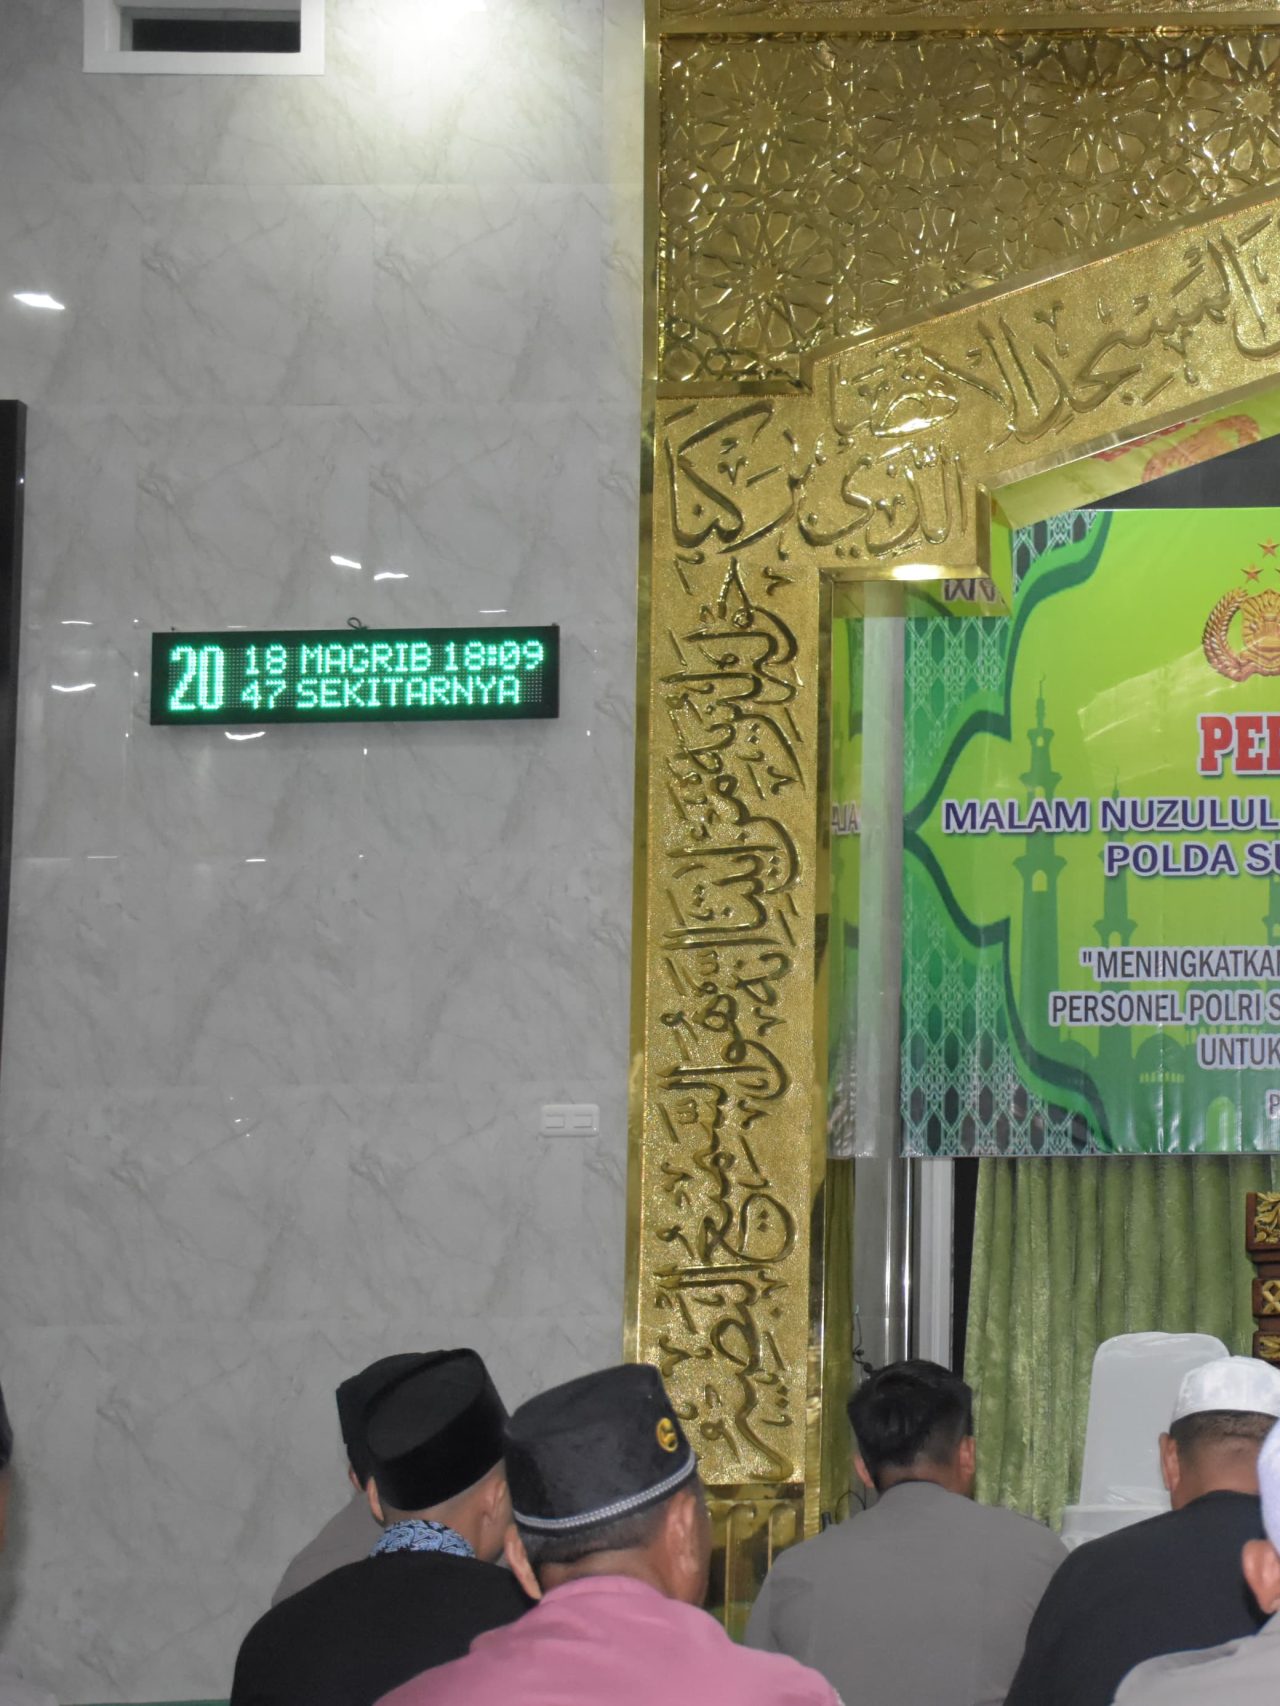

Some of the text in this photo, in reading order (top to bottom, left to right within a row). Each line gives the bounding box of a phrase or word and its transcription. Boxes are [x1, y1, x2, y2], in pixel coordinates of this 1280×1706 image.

[245, 640, 545, 675] 18 MAGRIB 18:09
[168, 645, 225, 711] 20
[241, 675, 521, 710] 47 SEKITARNYA
[944, 800, 1088, 831] MALAM
[1101, 797, 1280, 829] NUZULUL
[1106, 843, 1236, 873] POLDA
[1052, 994, 1183, 1023] PERSONEL
[1190, 993, 1262, 1021] POLRI
